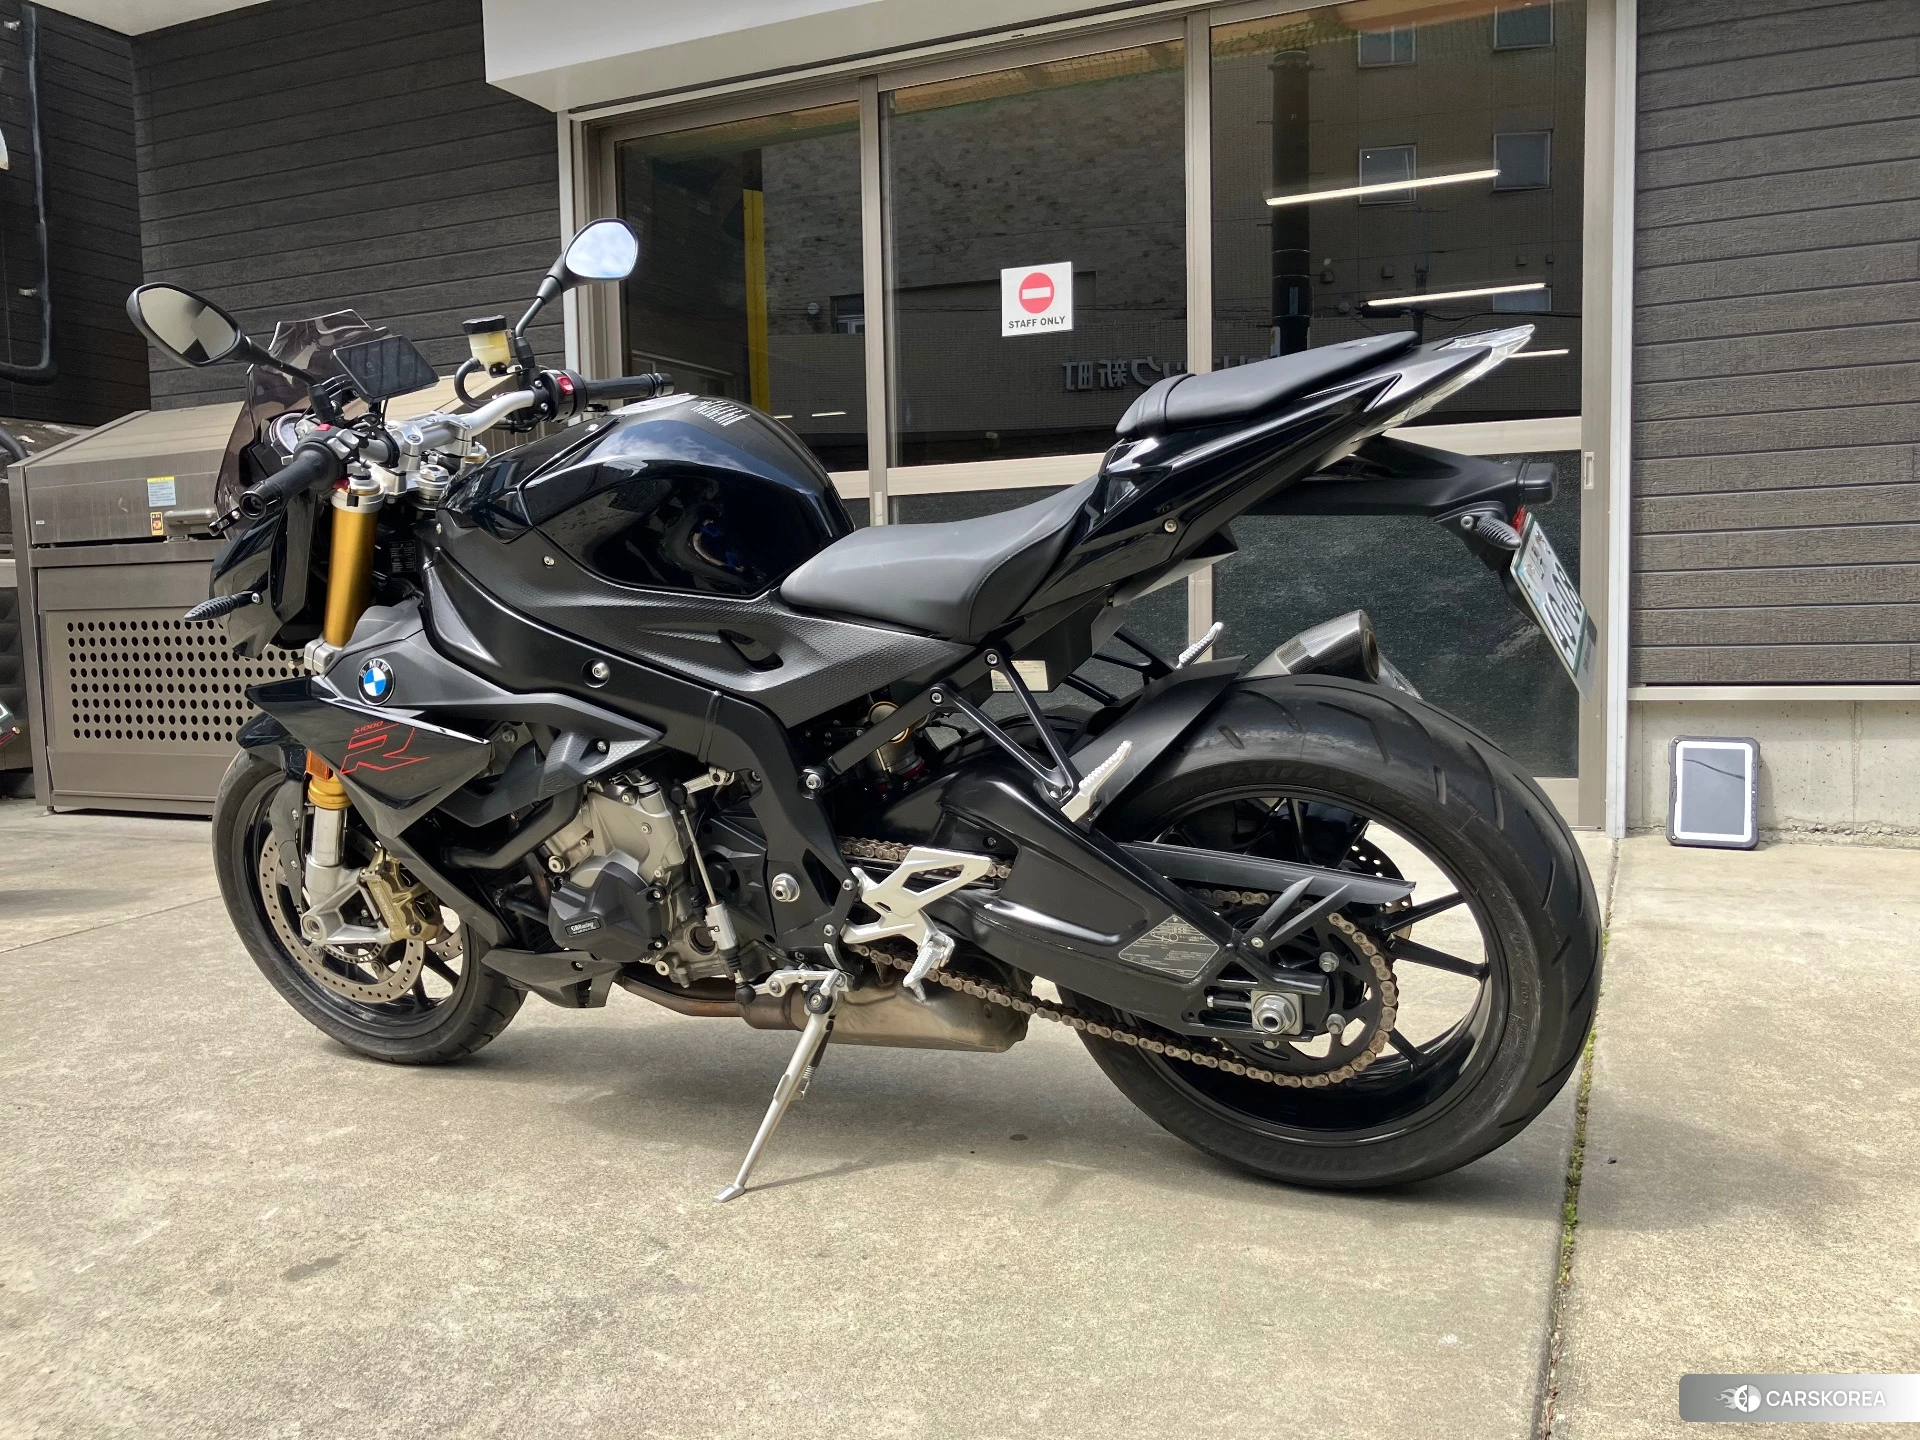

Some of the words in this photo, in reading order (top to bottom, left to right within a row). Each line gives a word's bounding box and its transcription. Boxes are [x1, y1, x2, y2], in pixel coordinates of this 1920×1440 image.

[1008, 318, 1037, 329] STAFF
[1040, 315, 1066, 326] ONLY
[359, 659, 390, 678] BMW
[353, 720, 385, 733] S1000
[340, 722, 431, 775] R
